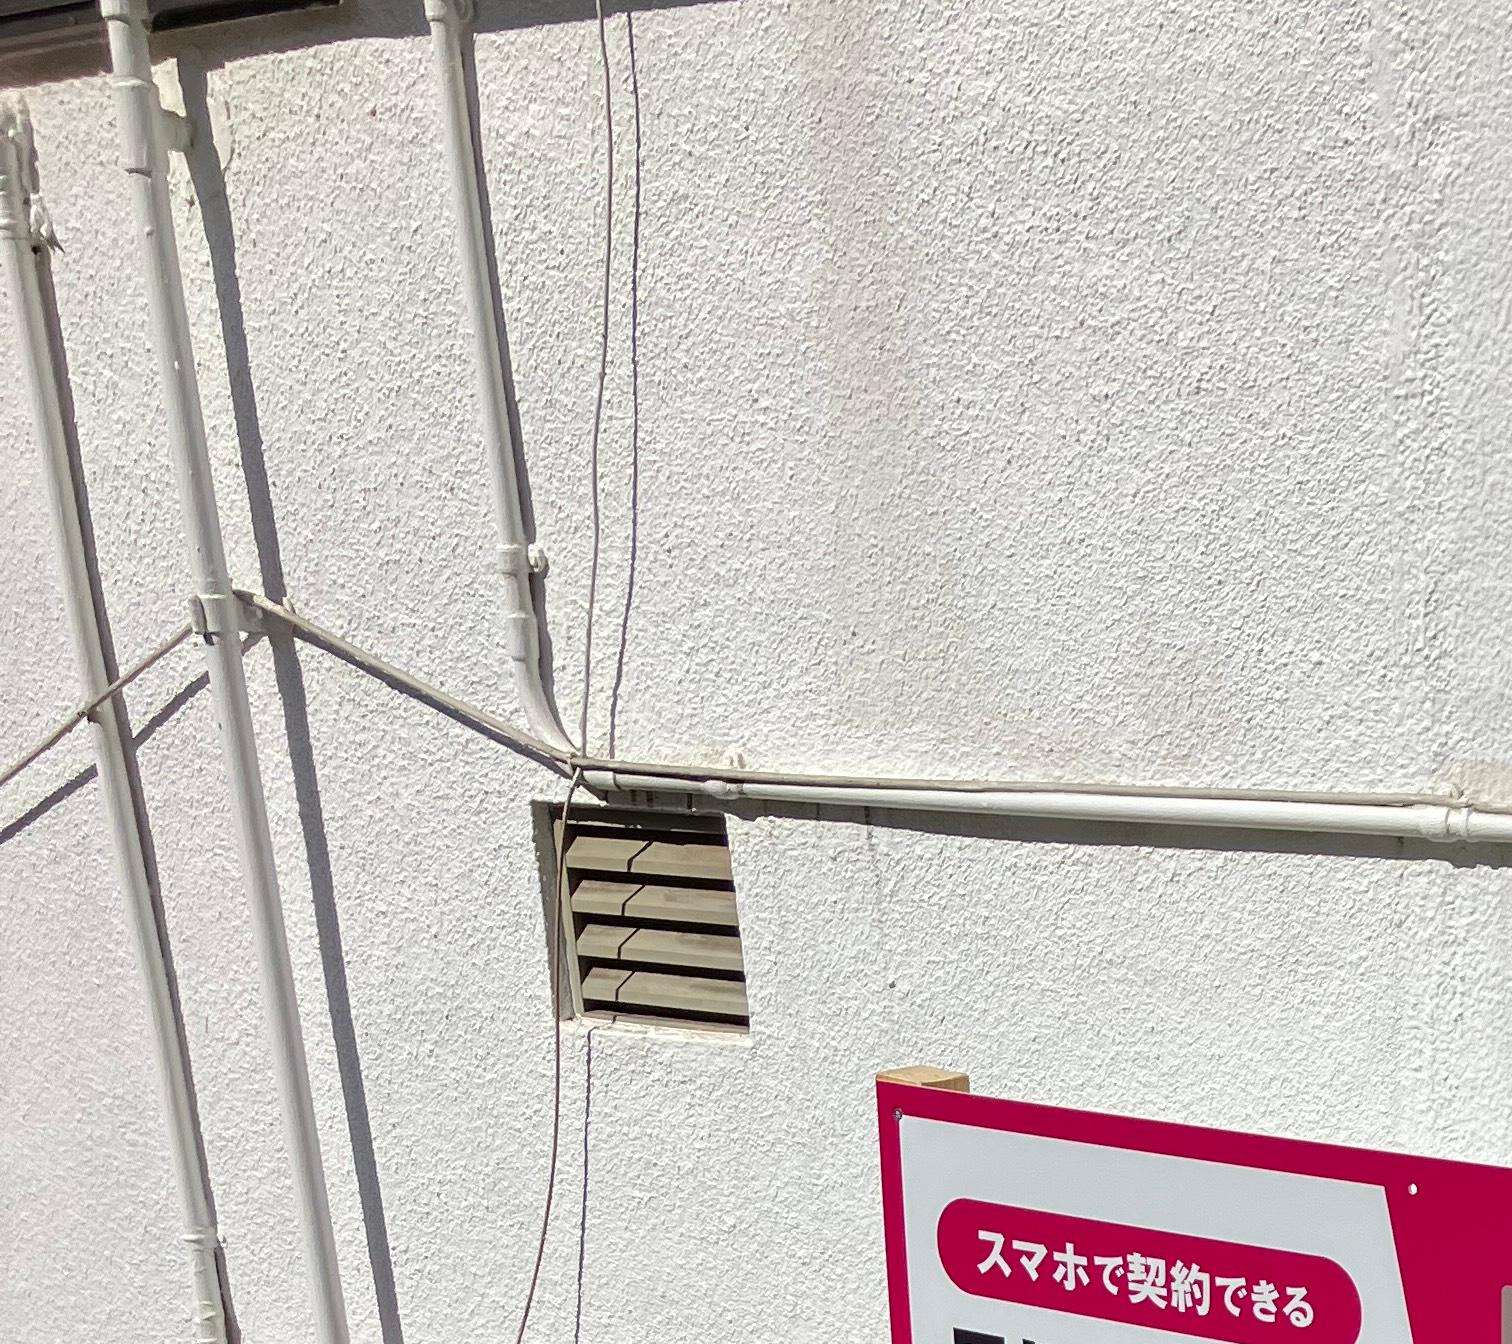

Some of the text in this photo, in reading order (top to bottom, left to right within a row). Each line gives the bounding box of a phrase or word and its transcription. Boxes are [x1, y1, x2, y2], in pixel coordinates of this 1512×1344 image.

[977, 1230, 1314, 1328] スマホで契約できる
